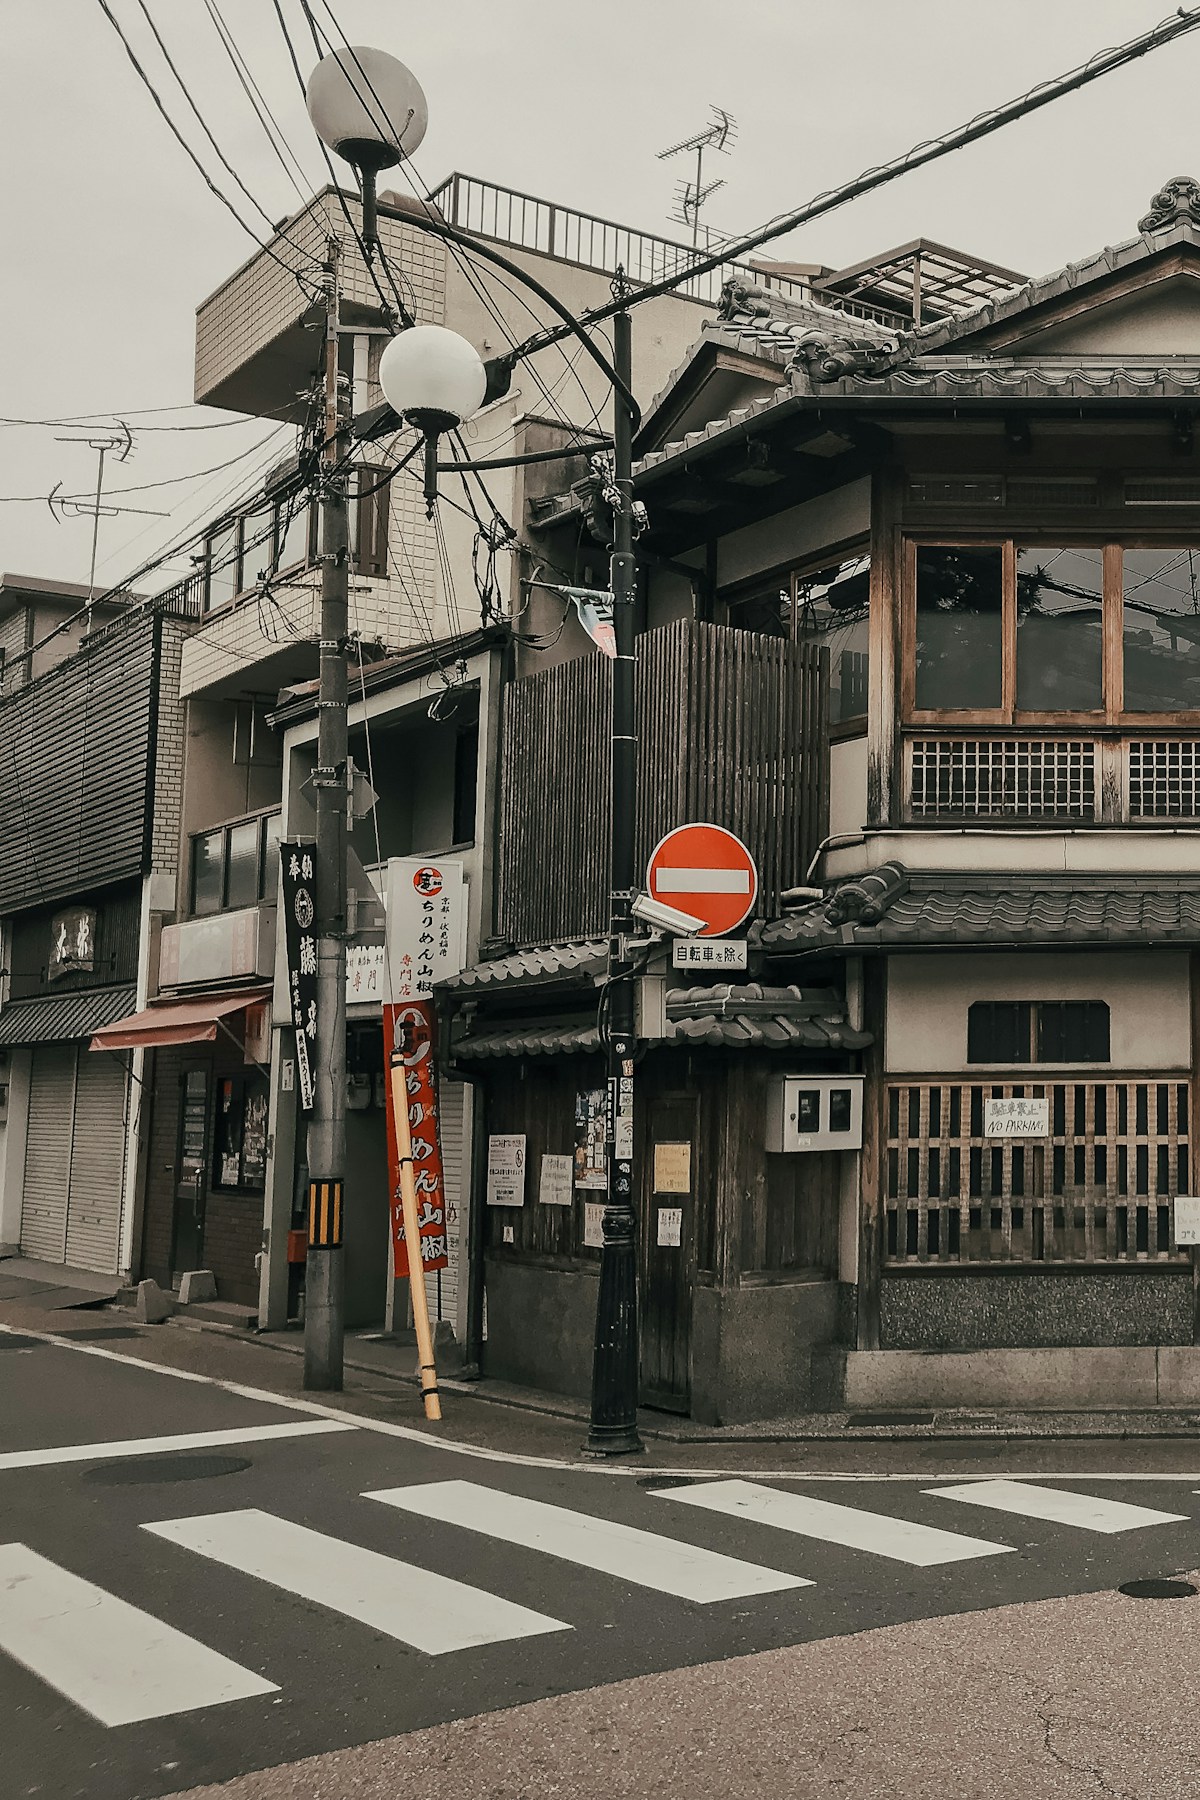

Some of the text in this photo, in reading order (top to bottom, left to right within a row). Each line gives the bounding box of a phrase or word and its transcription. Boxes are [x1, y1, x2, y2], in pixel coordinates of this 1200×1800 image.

[416, 900, 435, 993] ちりめん山椒
[677, 946, 744, 963] 自転車を除く
[399, 954, 413, 996] 専門店
[988, 1120, 1044, 1132] NO PARKING
[405, 1070, 448, 1262] ちりめん山椒
